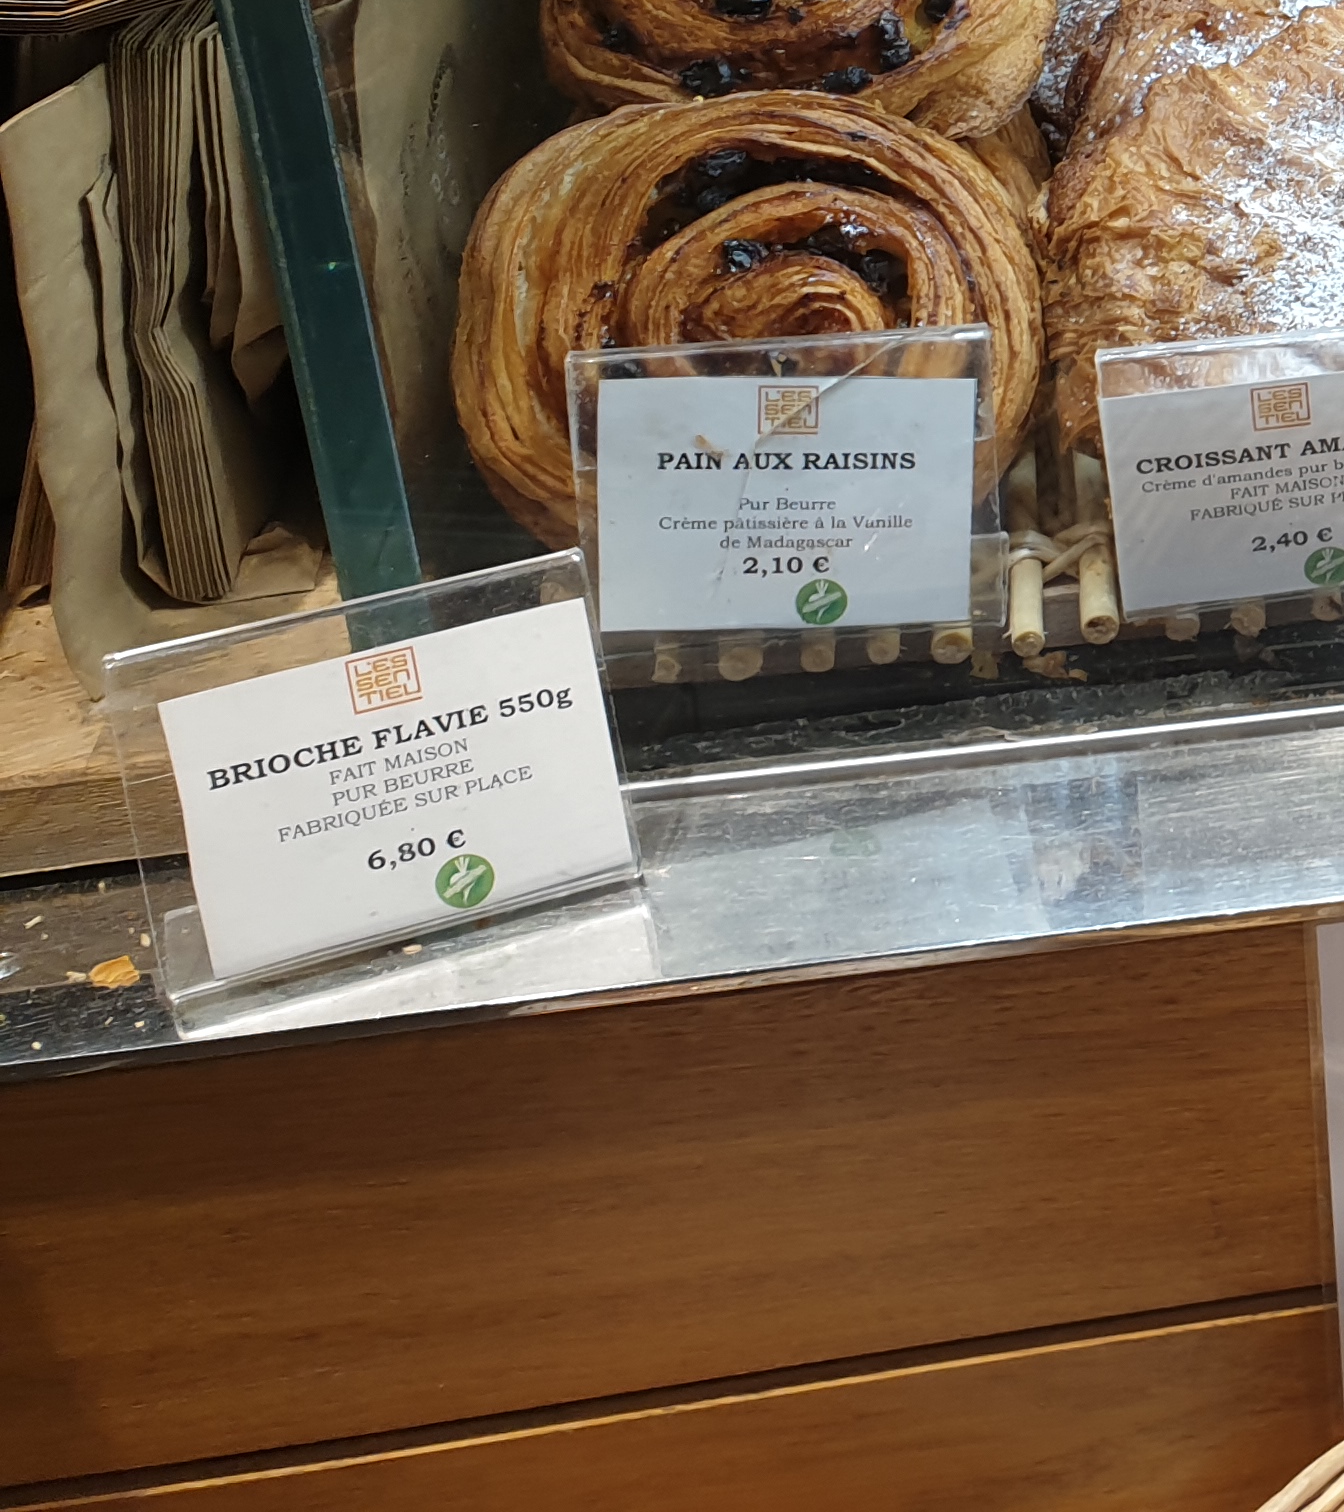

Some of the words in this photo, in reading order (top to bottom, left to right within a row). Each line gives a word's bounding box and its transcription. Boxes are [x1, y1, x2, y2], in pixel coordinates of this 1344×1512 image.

[657, 450, 723, 470] PAIN
[732, 452, 793, 470] AUX
[801, 452, 916, 471] RAISINS
[1135, 442, 1291, 475] CROISSANT
[1230, 483, 1270, 501] FAIT
[1274, 474, 1344, 495] MAISON
[738, 497, 770, 511] Pur
[775, 497, 837, 511] Beurre
[658, 516, 718, 530] Crème
[723, 515, 809, 534] pâtissière
[814, 516, 825, 530] à
[830, 515, 847, 530] la
[852, 514, 913, 529] Vanille
[1251, 530, 1309, 553] 2,40
[1316, 526, 1333, 543] €
[742, 556, 804, 578] 2,10
[812, 556, 830, 574] €
[206, 735, 363, 791] BRIOCHE
[371, 704, 489, 750] FLAVIE
[498, 687, 574, 718] 550g
[367, 837, 436, 871] 6,80
[446, 828, 467, 849] €
